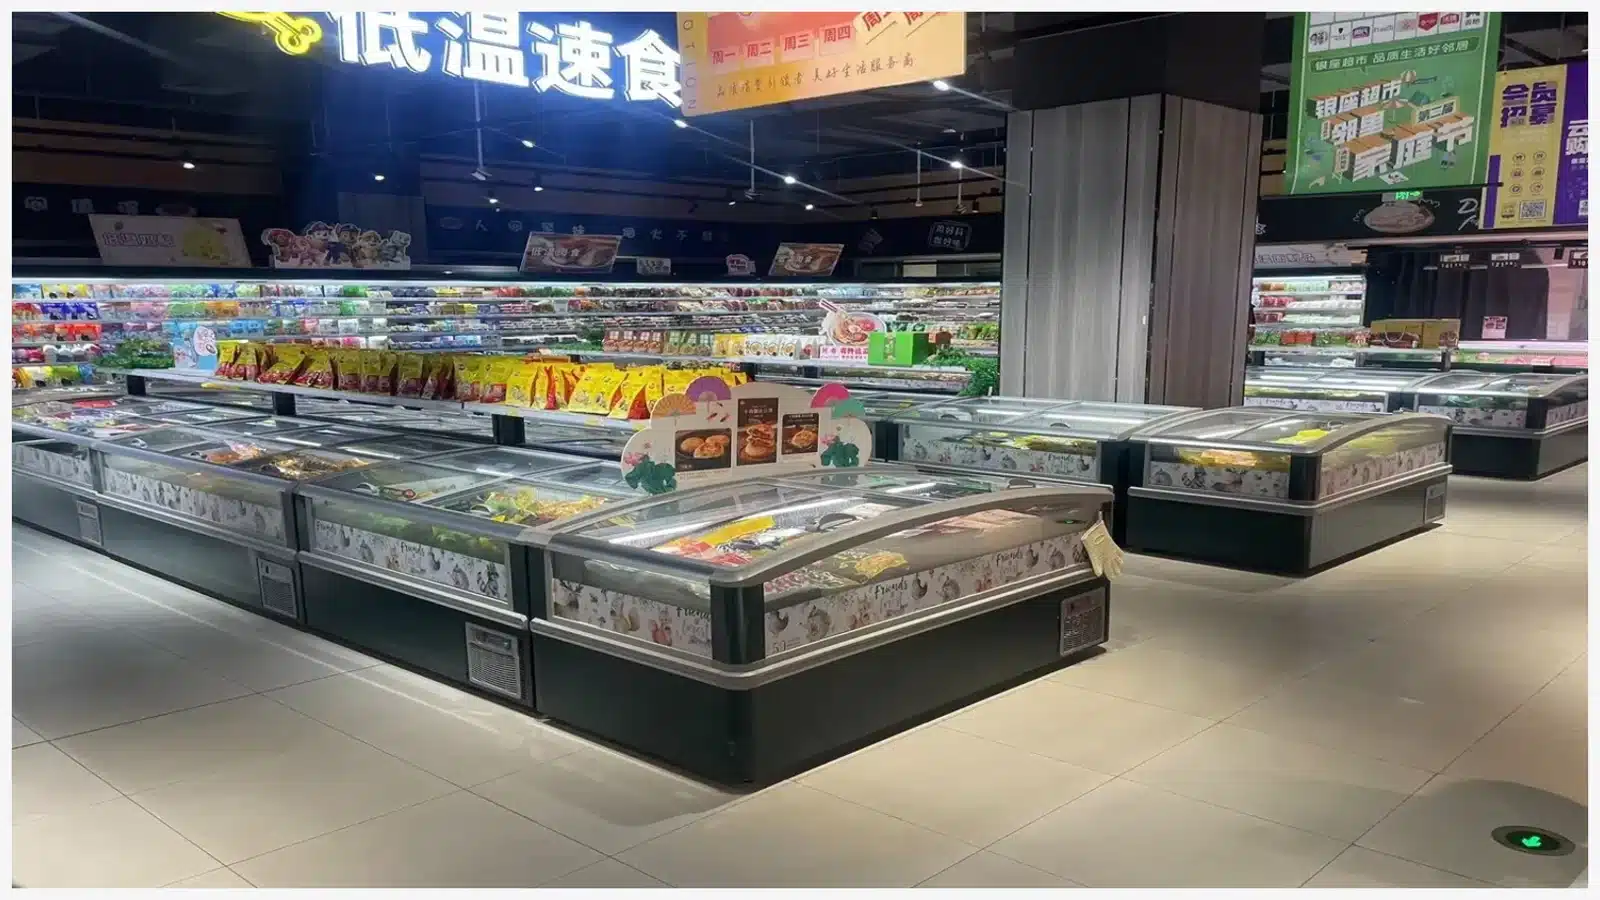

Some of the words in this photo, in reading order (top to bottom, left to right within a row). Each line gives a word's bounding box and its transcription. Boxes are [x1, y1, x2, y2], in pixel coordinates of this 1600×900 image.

[862, 12, 891, 31] 周
[784, 33, 810, 51] 周三
[823, 25, 851, 43] 周四
[712, 50, 736, 65] 周一
[747, 42, 772, 58] 周二
[1314, 55, 1368, 71] 银座超市
[1373, 40, 1469, 63] 品质生活好邻居
[327, 12, 683, 108] 低温速食
[1315, 80, 1402, 119] 银座超市
[1351, 115, 1475, 182] 家庭节
